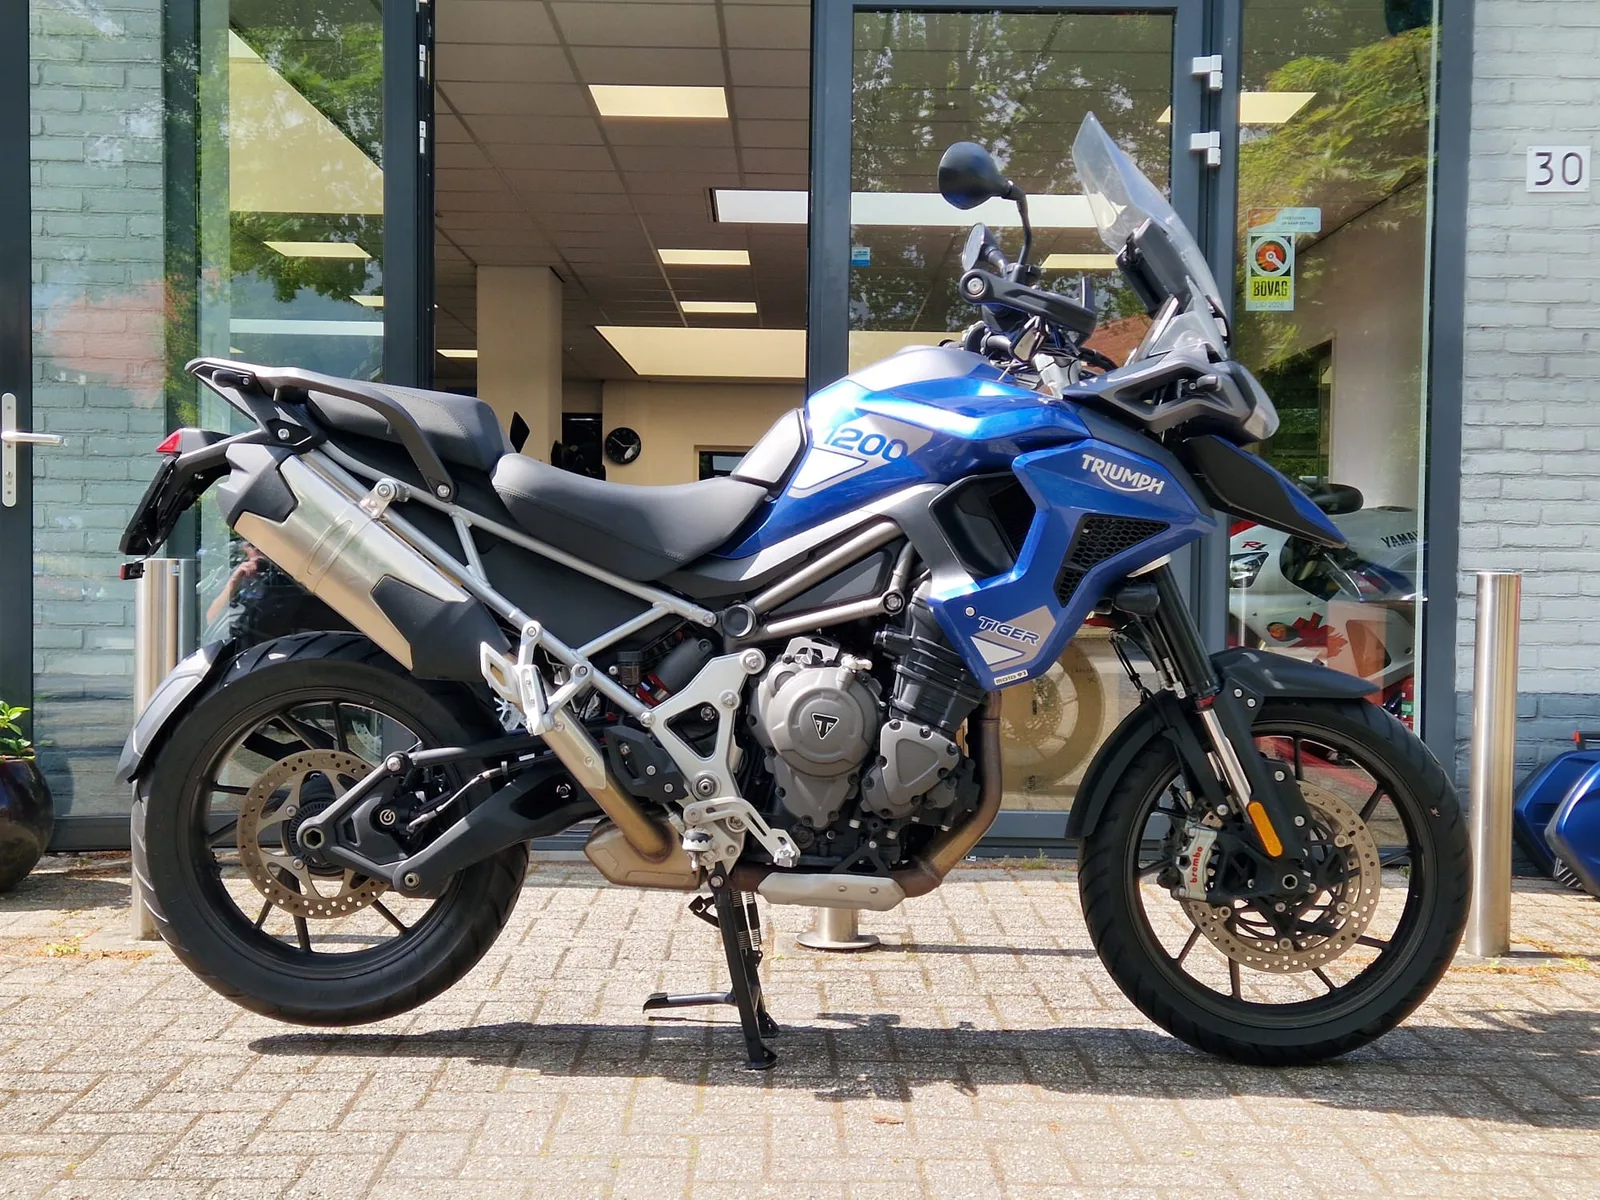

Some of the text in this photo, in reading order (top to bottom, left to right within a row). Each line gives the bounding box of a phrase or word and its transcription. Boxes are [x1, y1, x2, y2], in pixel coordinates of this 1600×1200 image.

[1535, 151, 1583, 186] 30
[1253, 280, 1288, 297] BOVAG
[823, 425, 909, 462] 1200
[1082, 453, 1165, 495] TRIUMPH
[979, 616, 1039, 645] TIGER
[1189, 846, 1204, 884] brembo
